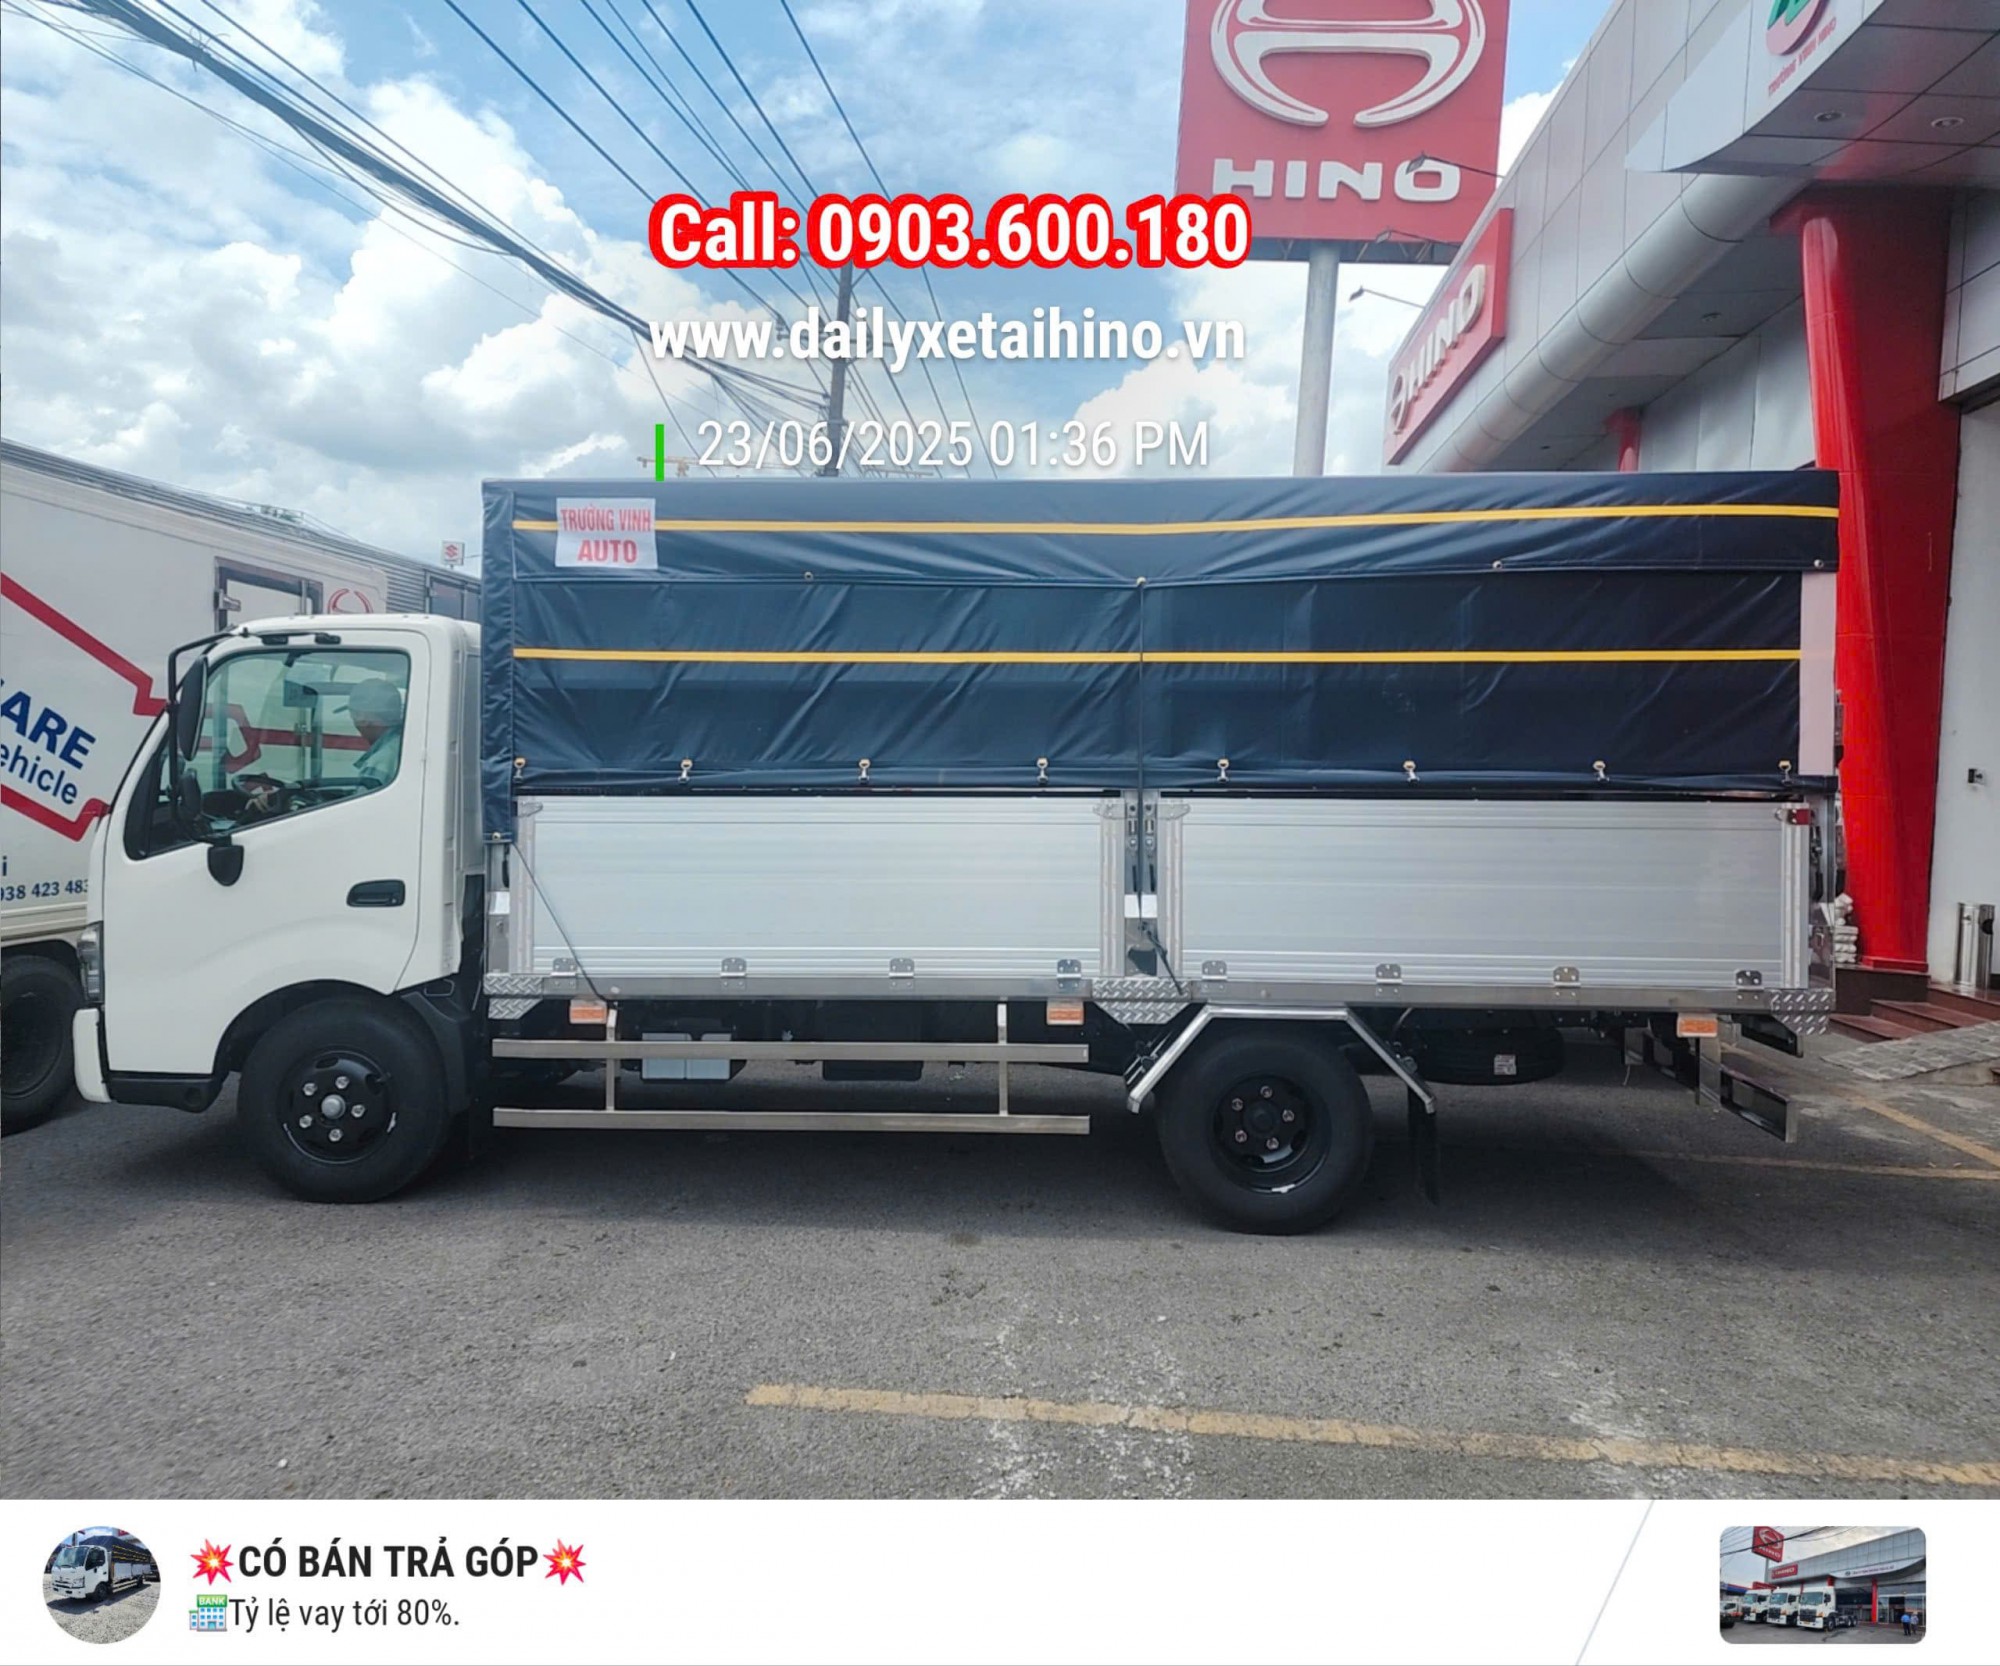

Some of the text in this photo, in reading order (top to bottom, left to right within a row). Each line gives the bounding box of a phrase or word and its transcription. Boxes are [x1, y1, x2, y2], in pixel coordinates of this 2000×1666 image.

[1212, 158, 1461, 203] HINO
[1407, 264, 1487, 402] HINO
[560, 503, 651, 532] TRƯỜNG VINH
[577, 540, 638, 563] AUTO
[0, 679, 97, 770] ARE
[31, 881, 60, 898] 423
